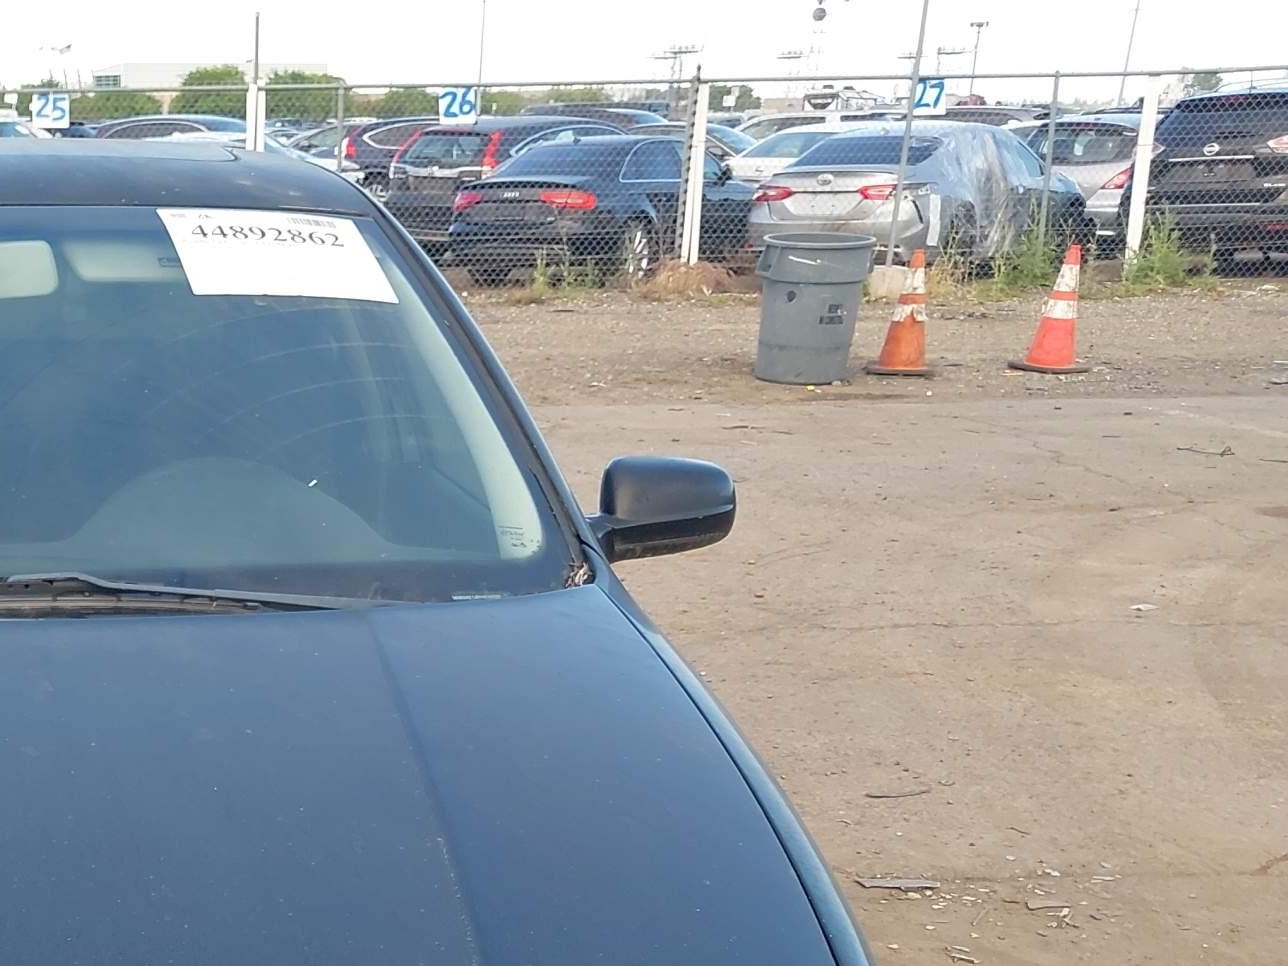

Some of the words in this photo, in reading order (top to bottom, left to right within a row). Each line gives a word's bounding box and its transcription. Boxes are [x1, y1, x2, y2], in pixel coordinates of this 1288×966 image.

[35, 91, 66, 120] 25
[439, 87, 476, 118] 26
[913, 79, 945, 109] 27
[191, 224, 345, 248] 44892862
